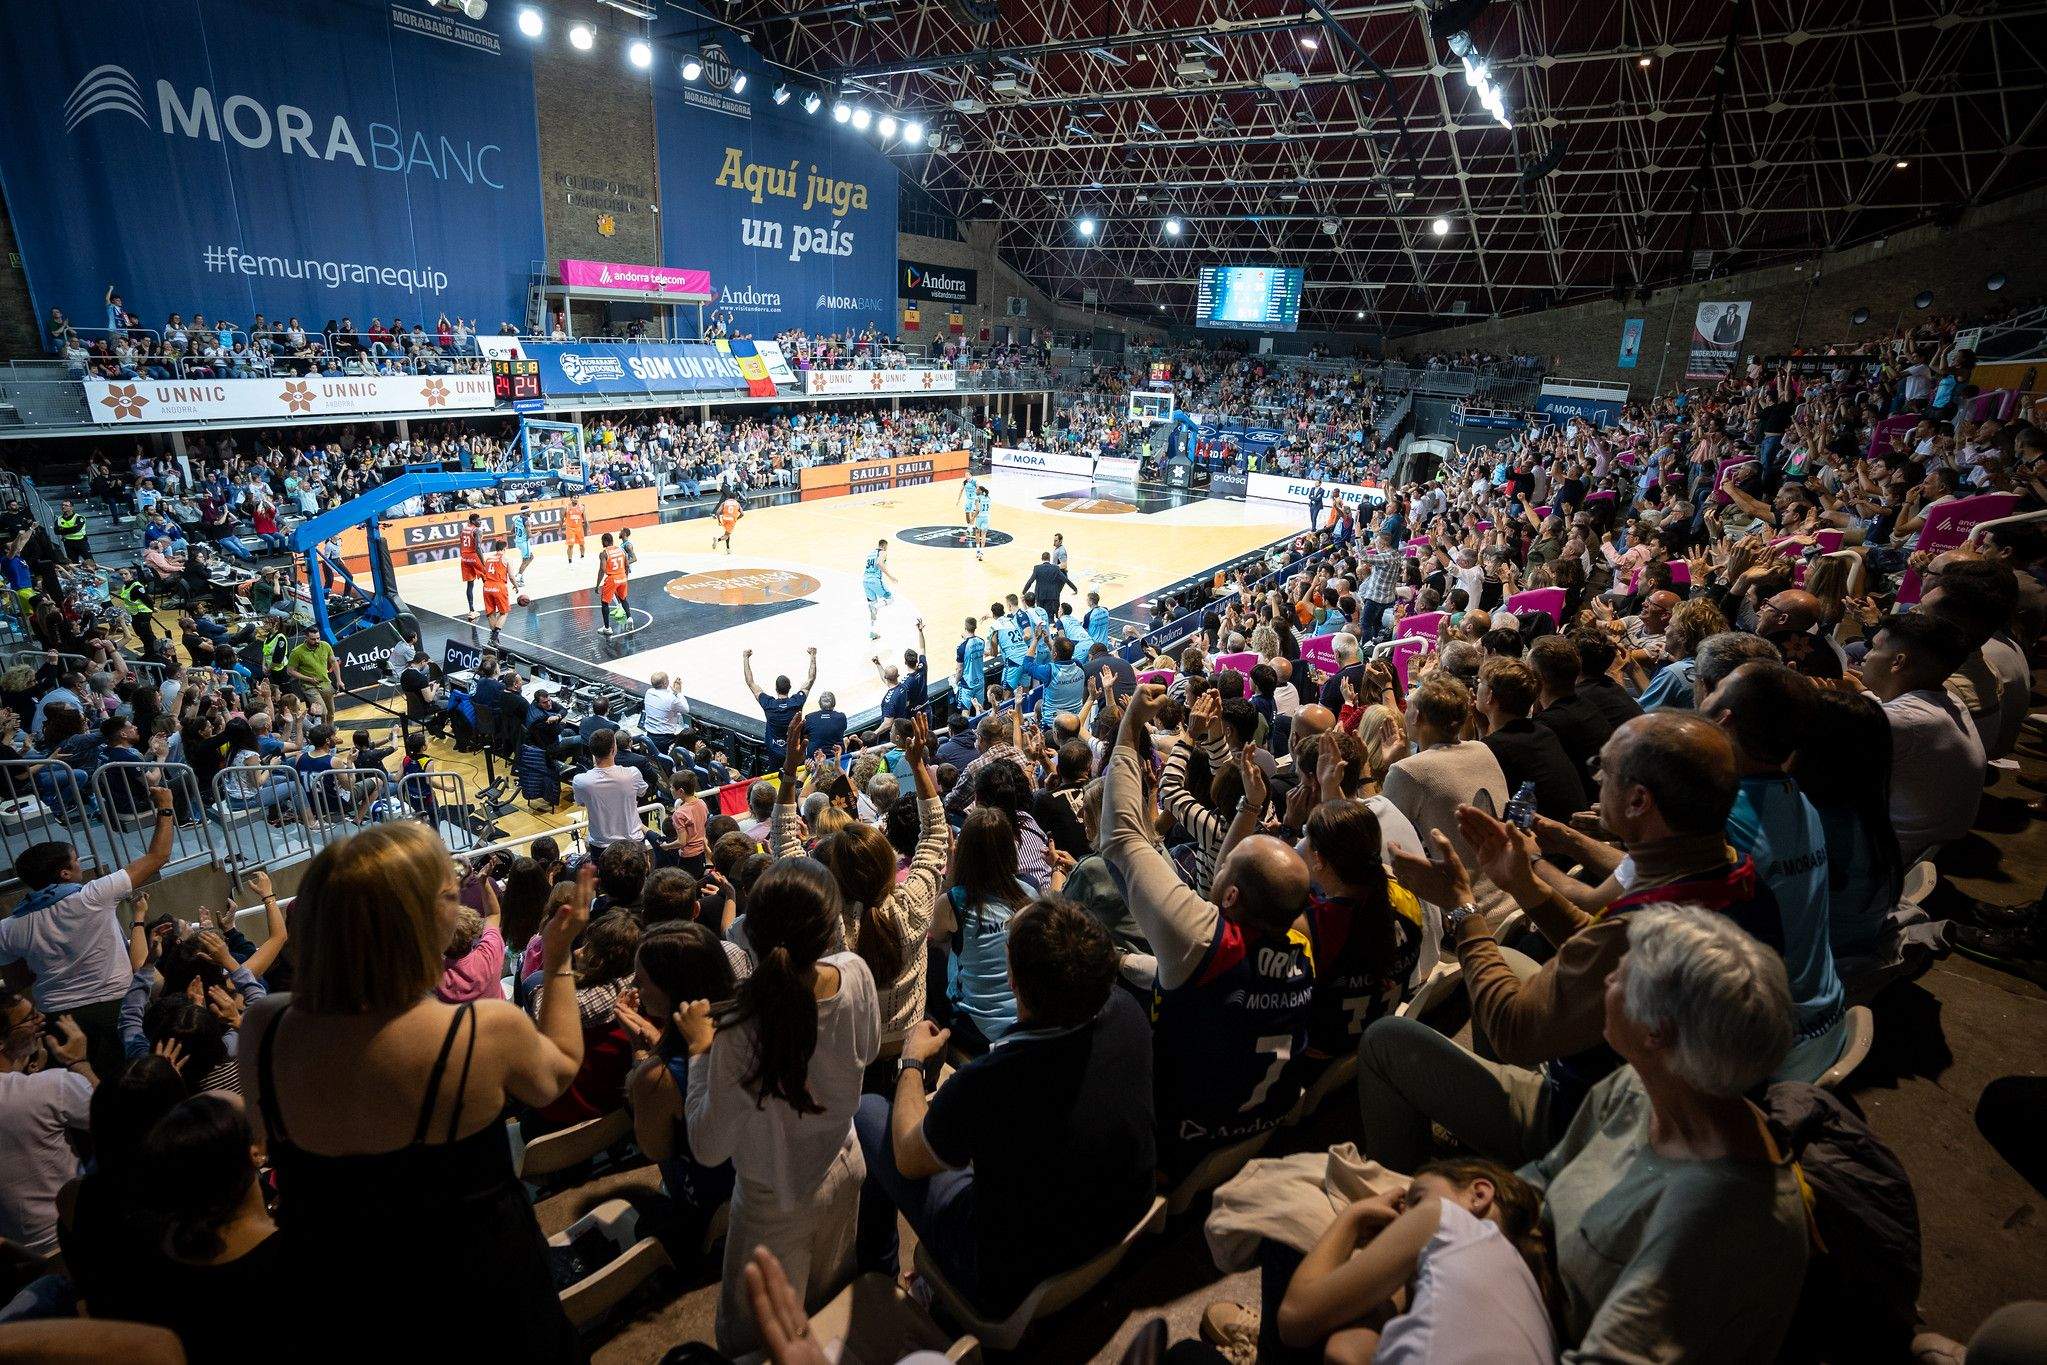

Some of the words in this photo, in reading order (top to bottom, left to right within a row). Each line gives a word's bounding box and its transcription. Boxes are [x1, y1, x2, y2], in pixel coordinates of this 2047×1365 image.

[392, 10, 453, 37] MORABANC
[454, 26, 501, 50] ANDORRA
[684, 90, 721, 108] MORABANC
[722, 101, 752, 116] ANDORRA
[156, 78, 504, 189] MORABANC
[715, 147, 800, 204] Aquí
[802, 164, 868, 217] juga
[741, 217, 783, 249] un
[789, 219, 854, 262] país
[203, 245, 448, 295] #femungranequip
[614, 271, 649, 284] andorra
[650, 273, 686, 286] telecom
[921, 271, 967, 292] Andorra
[719, 285, 781, 306] Andorra
[827, 296, 883, 312] MORABANC
[930, 291, 967, 301] visitandorra.com
[720, 305, 782, 313] www.visitandorra.com
[628, 356, 674, 380] SOM
[676, 357, 707, 380] UN
[704, 352, 743, 378] PAÍS
[828, 374, 853, 384] UNNIC
[885, 373, 906, 383] UNNIC
[935, 373, 954, 382] UNNIC
[322, 383, 378, 398] UNNIC
[455, 381, 492, 395] UNNI
[515, 377, 538, 397] 24
[156, 386, 226, 404] UNNIC
[161, 406, 197, 415] ANDORRA
[852, 465, 890, 480] SAULA
[898, 461, 932, 474] SAULA
[511, 480, 547, 490] endesa
[1213, 474, 1246, 485] endesa
[1288, 485, 1310, 496] FEU
[463, 535, 471, 547] 21
[487, 563, 495, 575] 4
[611, 557, 624, 571] 37
[1008, 629, 1023, 644] 23
[1238, 1034, 1293, 1112] 7
